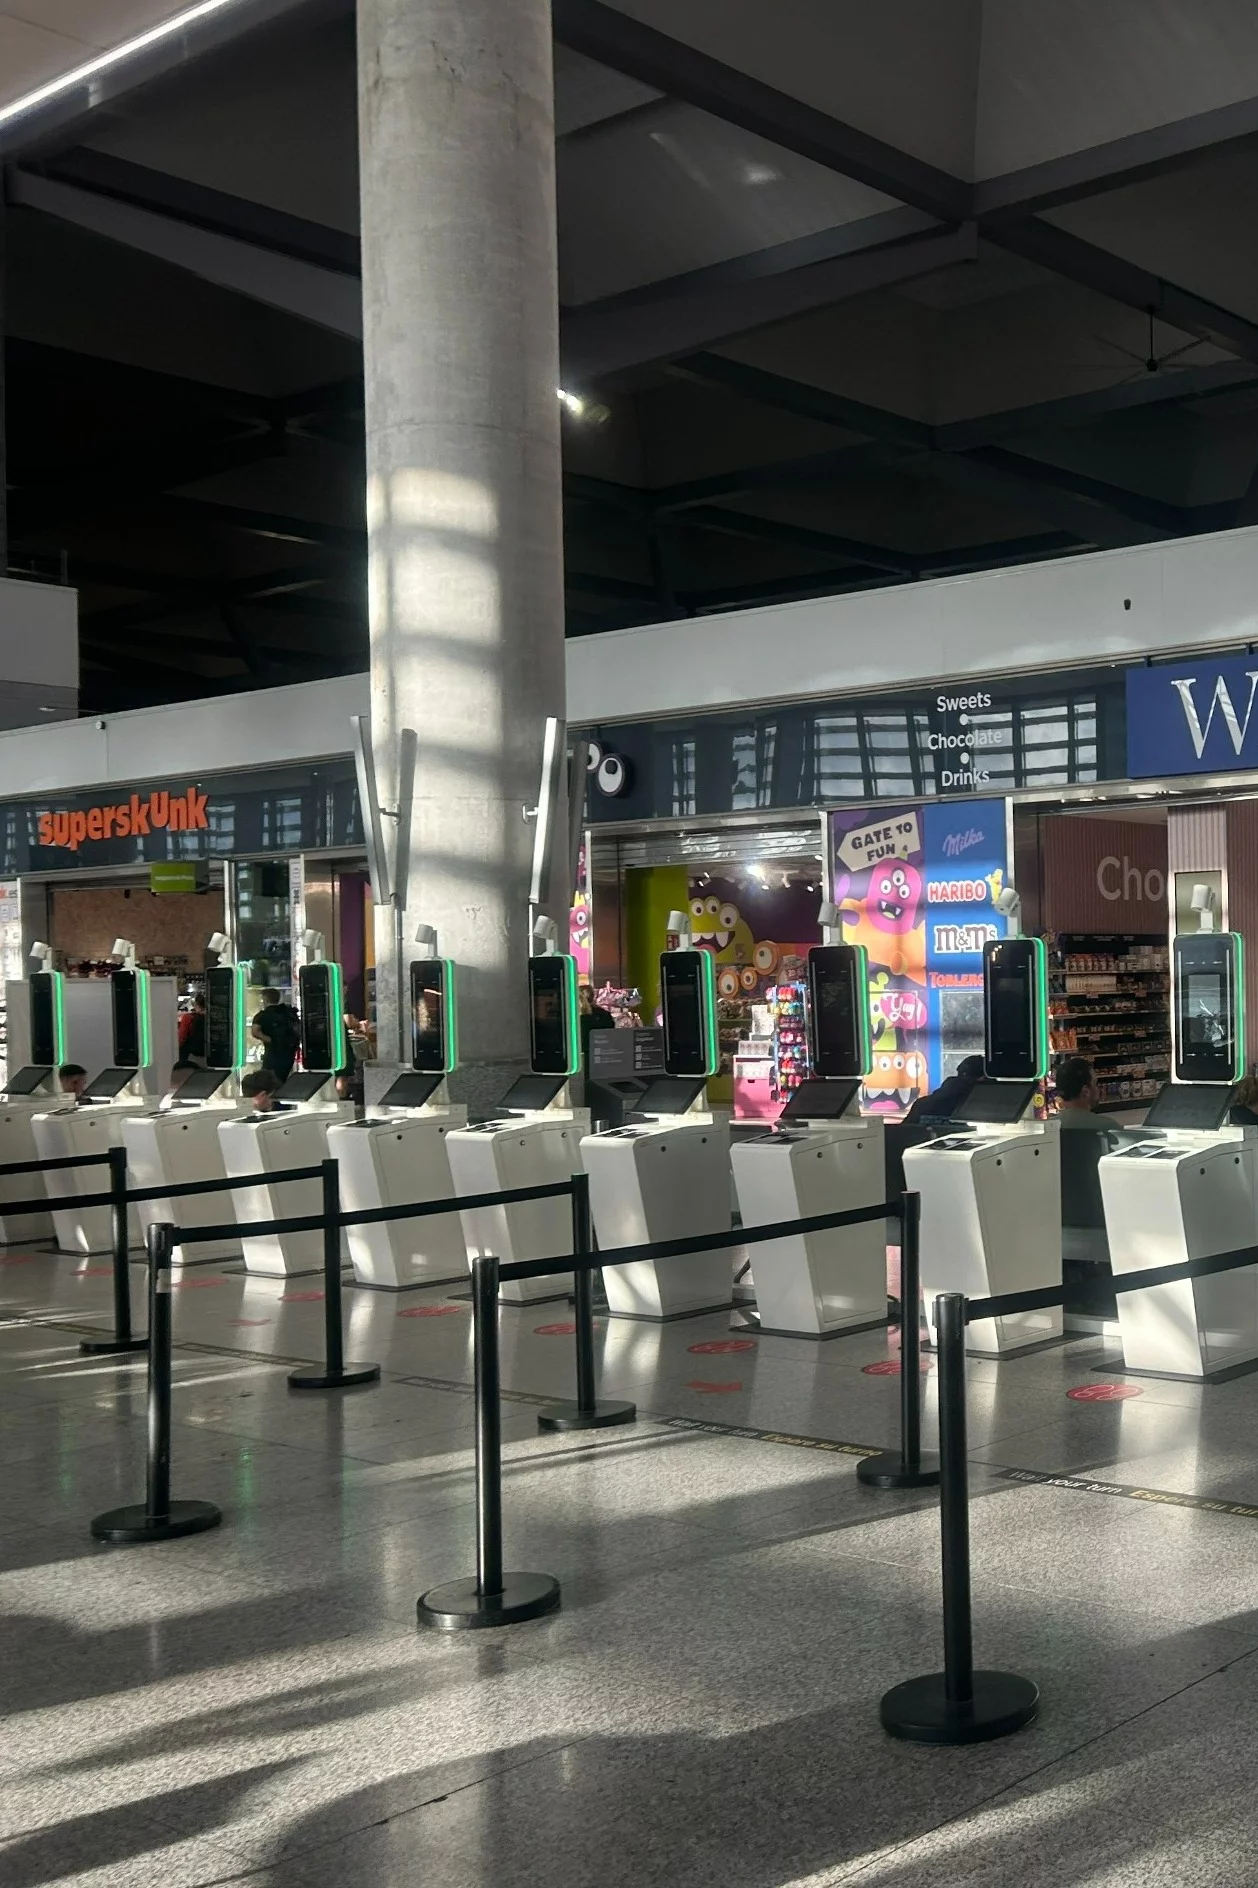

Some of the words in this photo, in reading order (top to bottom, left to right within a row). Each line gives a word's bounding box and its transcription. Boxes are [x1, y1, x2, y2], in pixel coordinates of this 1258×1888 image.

[936, 692, 991, 712] Sweets
[928, 729, 1003, 750] Chocolate
[941, 766, 990, 787] Drinks
[851, 826, 893, 850] GATE
[896, 821, 913, 834] TO
[943, 828, 985, 856] Milka
[867, 843, 896, 861] FUN
[928, 881, 985, 901] HARIBO
[1041, 1477, 1084, 1488] your
[1201, 1501, 1224, 1510] su
